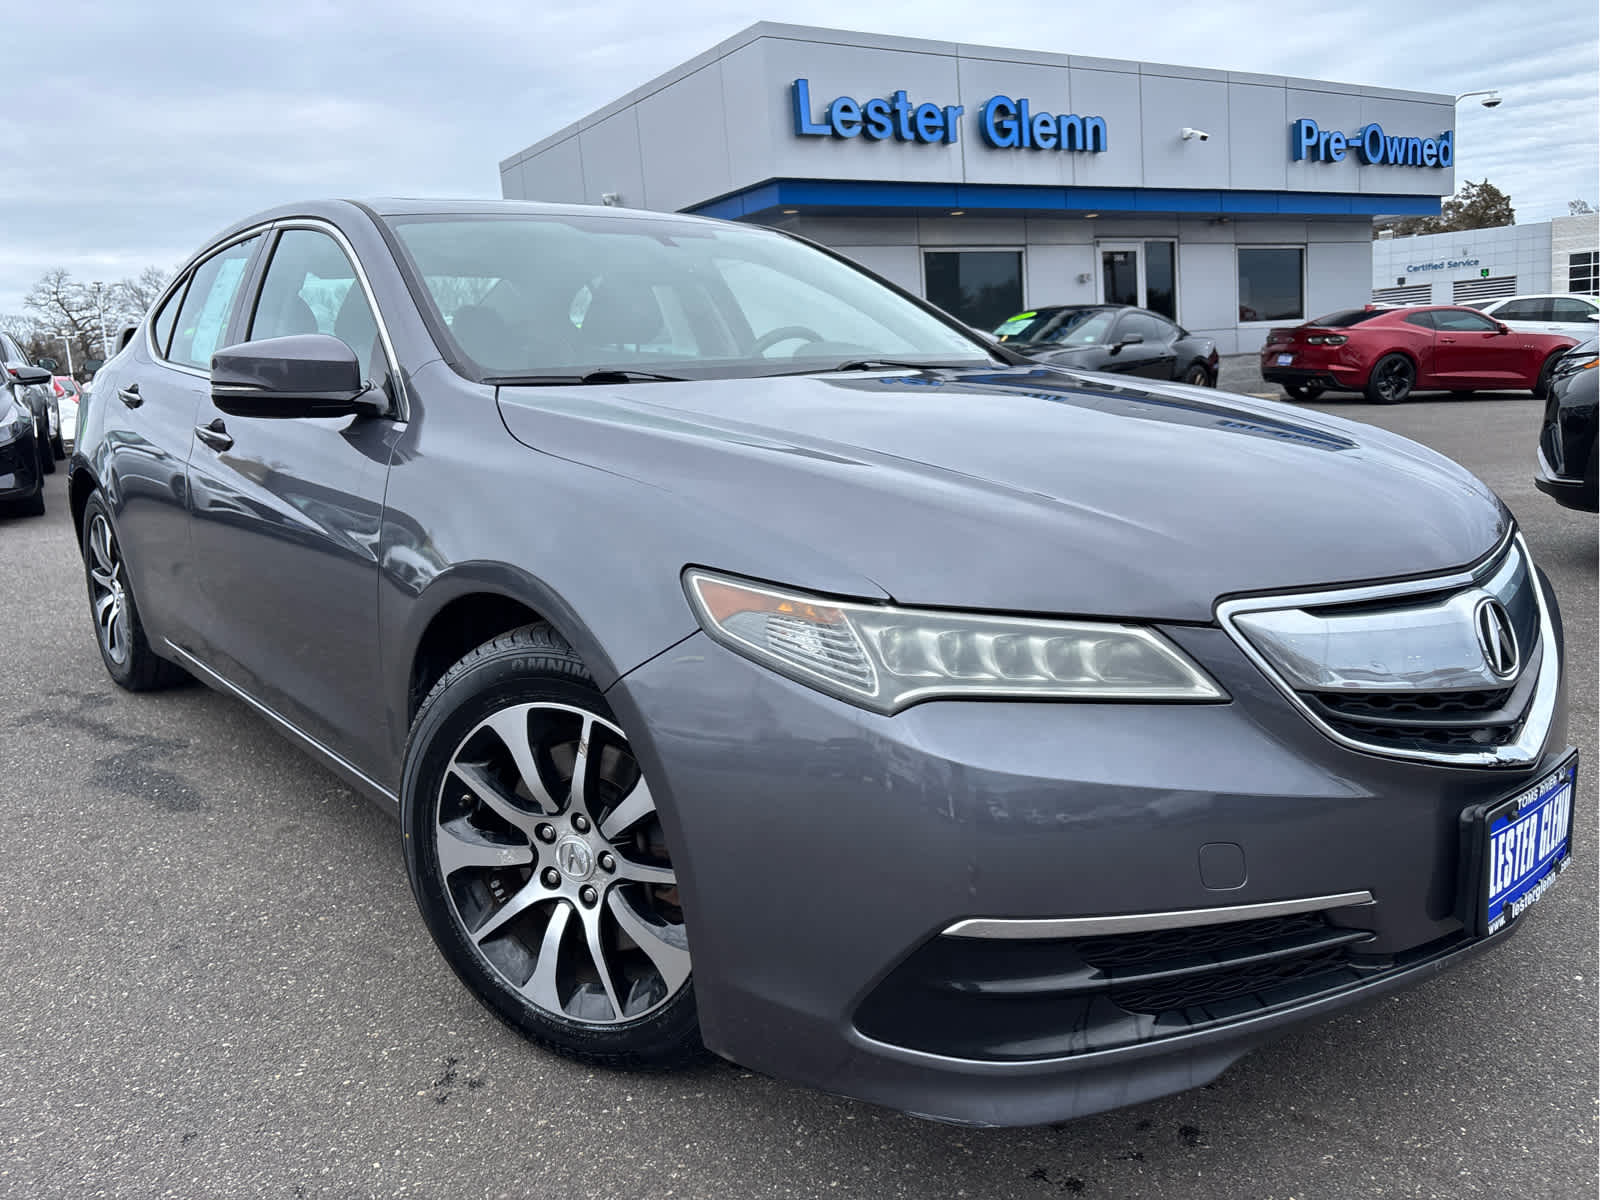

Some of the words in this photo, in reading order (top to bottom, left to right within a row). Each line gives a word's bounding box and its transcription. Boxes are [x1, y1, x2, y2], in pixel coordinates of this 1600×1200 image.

[792, 79, 964, 144] Lester
[980, 95, 1107, 152] Glenn
[1293, 118, 1453, 168] Pre-Owned
[1406, 261, 1445, 273] Certified
[1447, 259, 1480, 269] Service
[1517, 787, 1539, 811] TOMS
[1489, 812, 1539, 899] LESTER
[1538, 783, 1572, 861] GLENN
